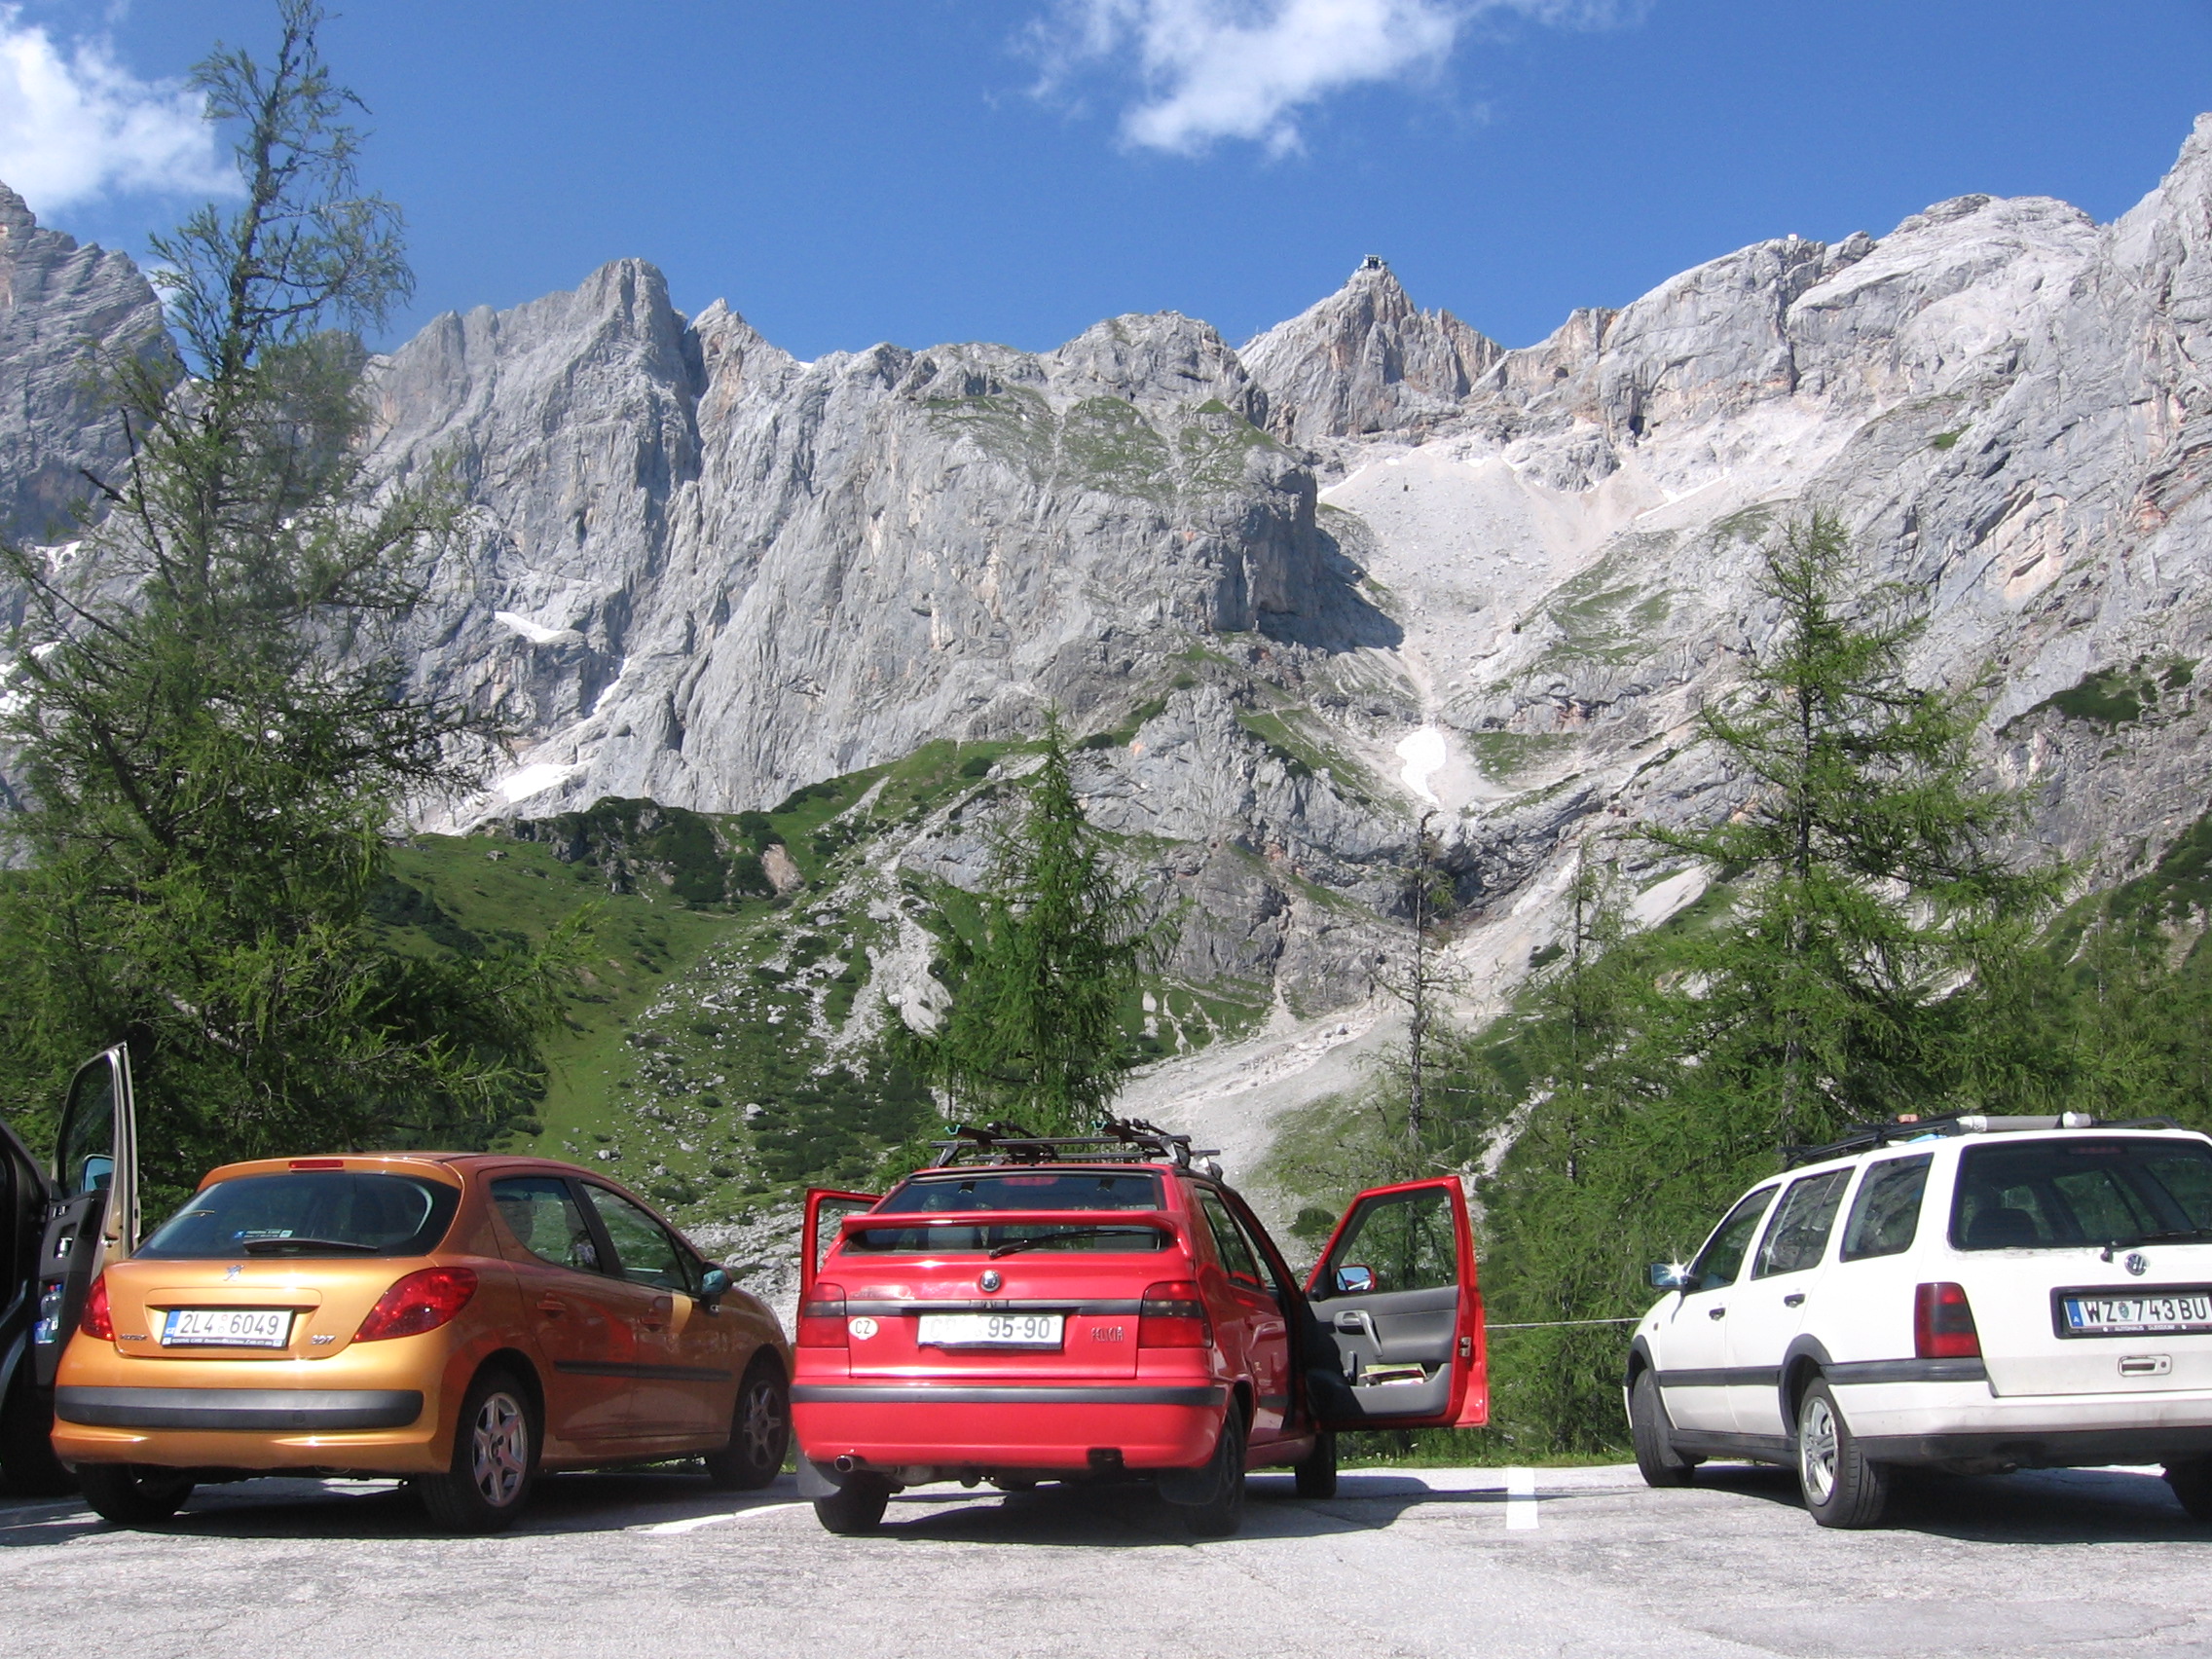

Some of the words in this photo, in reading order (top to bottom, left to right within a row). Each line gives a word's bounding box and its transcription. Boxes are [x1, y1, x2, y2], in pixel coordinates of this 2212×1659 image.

[2083, 1302, 2118, 1323] WZ
[180, 1313, 215, 1334] 2L4
[230, 1313, 279, 1336] 6049
[854, 1320, 871, 1335] CZ
[988, 1316, 1051, 1339] 95-90
[311, 1335, 336, 1346] 207
